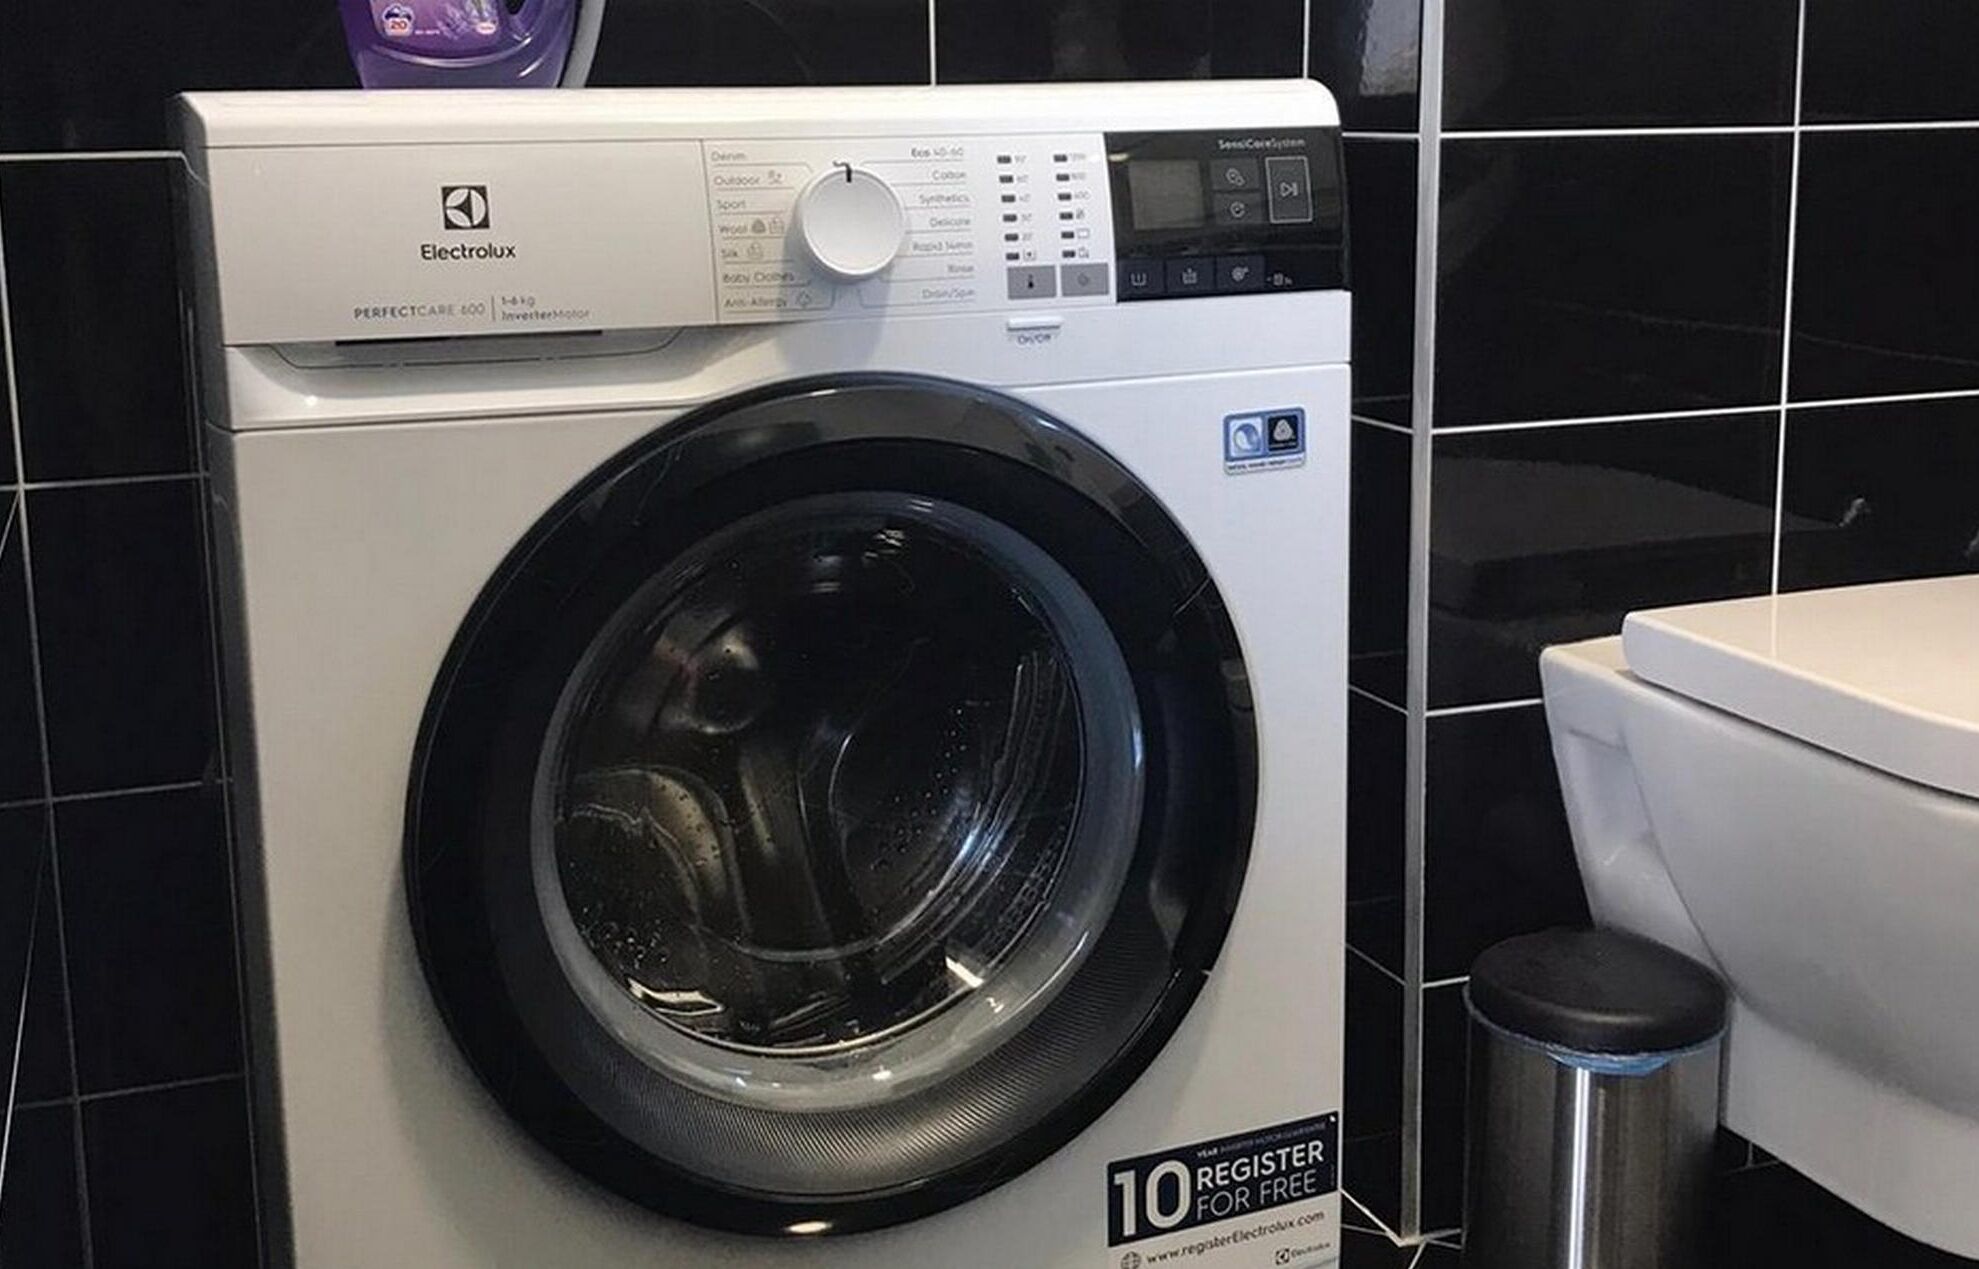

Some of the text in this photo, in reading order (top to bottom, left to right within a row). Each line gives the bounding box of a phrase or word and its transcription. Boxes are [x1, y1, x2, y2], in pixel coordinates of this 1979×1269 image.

[390, 19, 408, 31] 20
[710, 150, 747, 161] Denim
[910, 147, 931, 157] Eco
[713, 175, 761, 186] Outdoor
[716, 200, 747, 211] Sport
[929, 217, 971, 228] Delicate
[420, 243, 517, 261] Electrolux
[353, 303, 486, 320] PERFECTCARE 600
[501, 309, 590, 321] InverterMotor
[1197, 1140, 1325, 1191] REGISTER
[1113, 1159, 1192, 1238] 10
[1197, 1186, 1250, 1221] FOR
[1259, 1168, 1317, 1205] FREE
